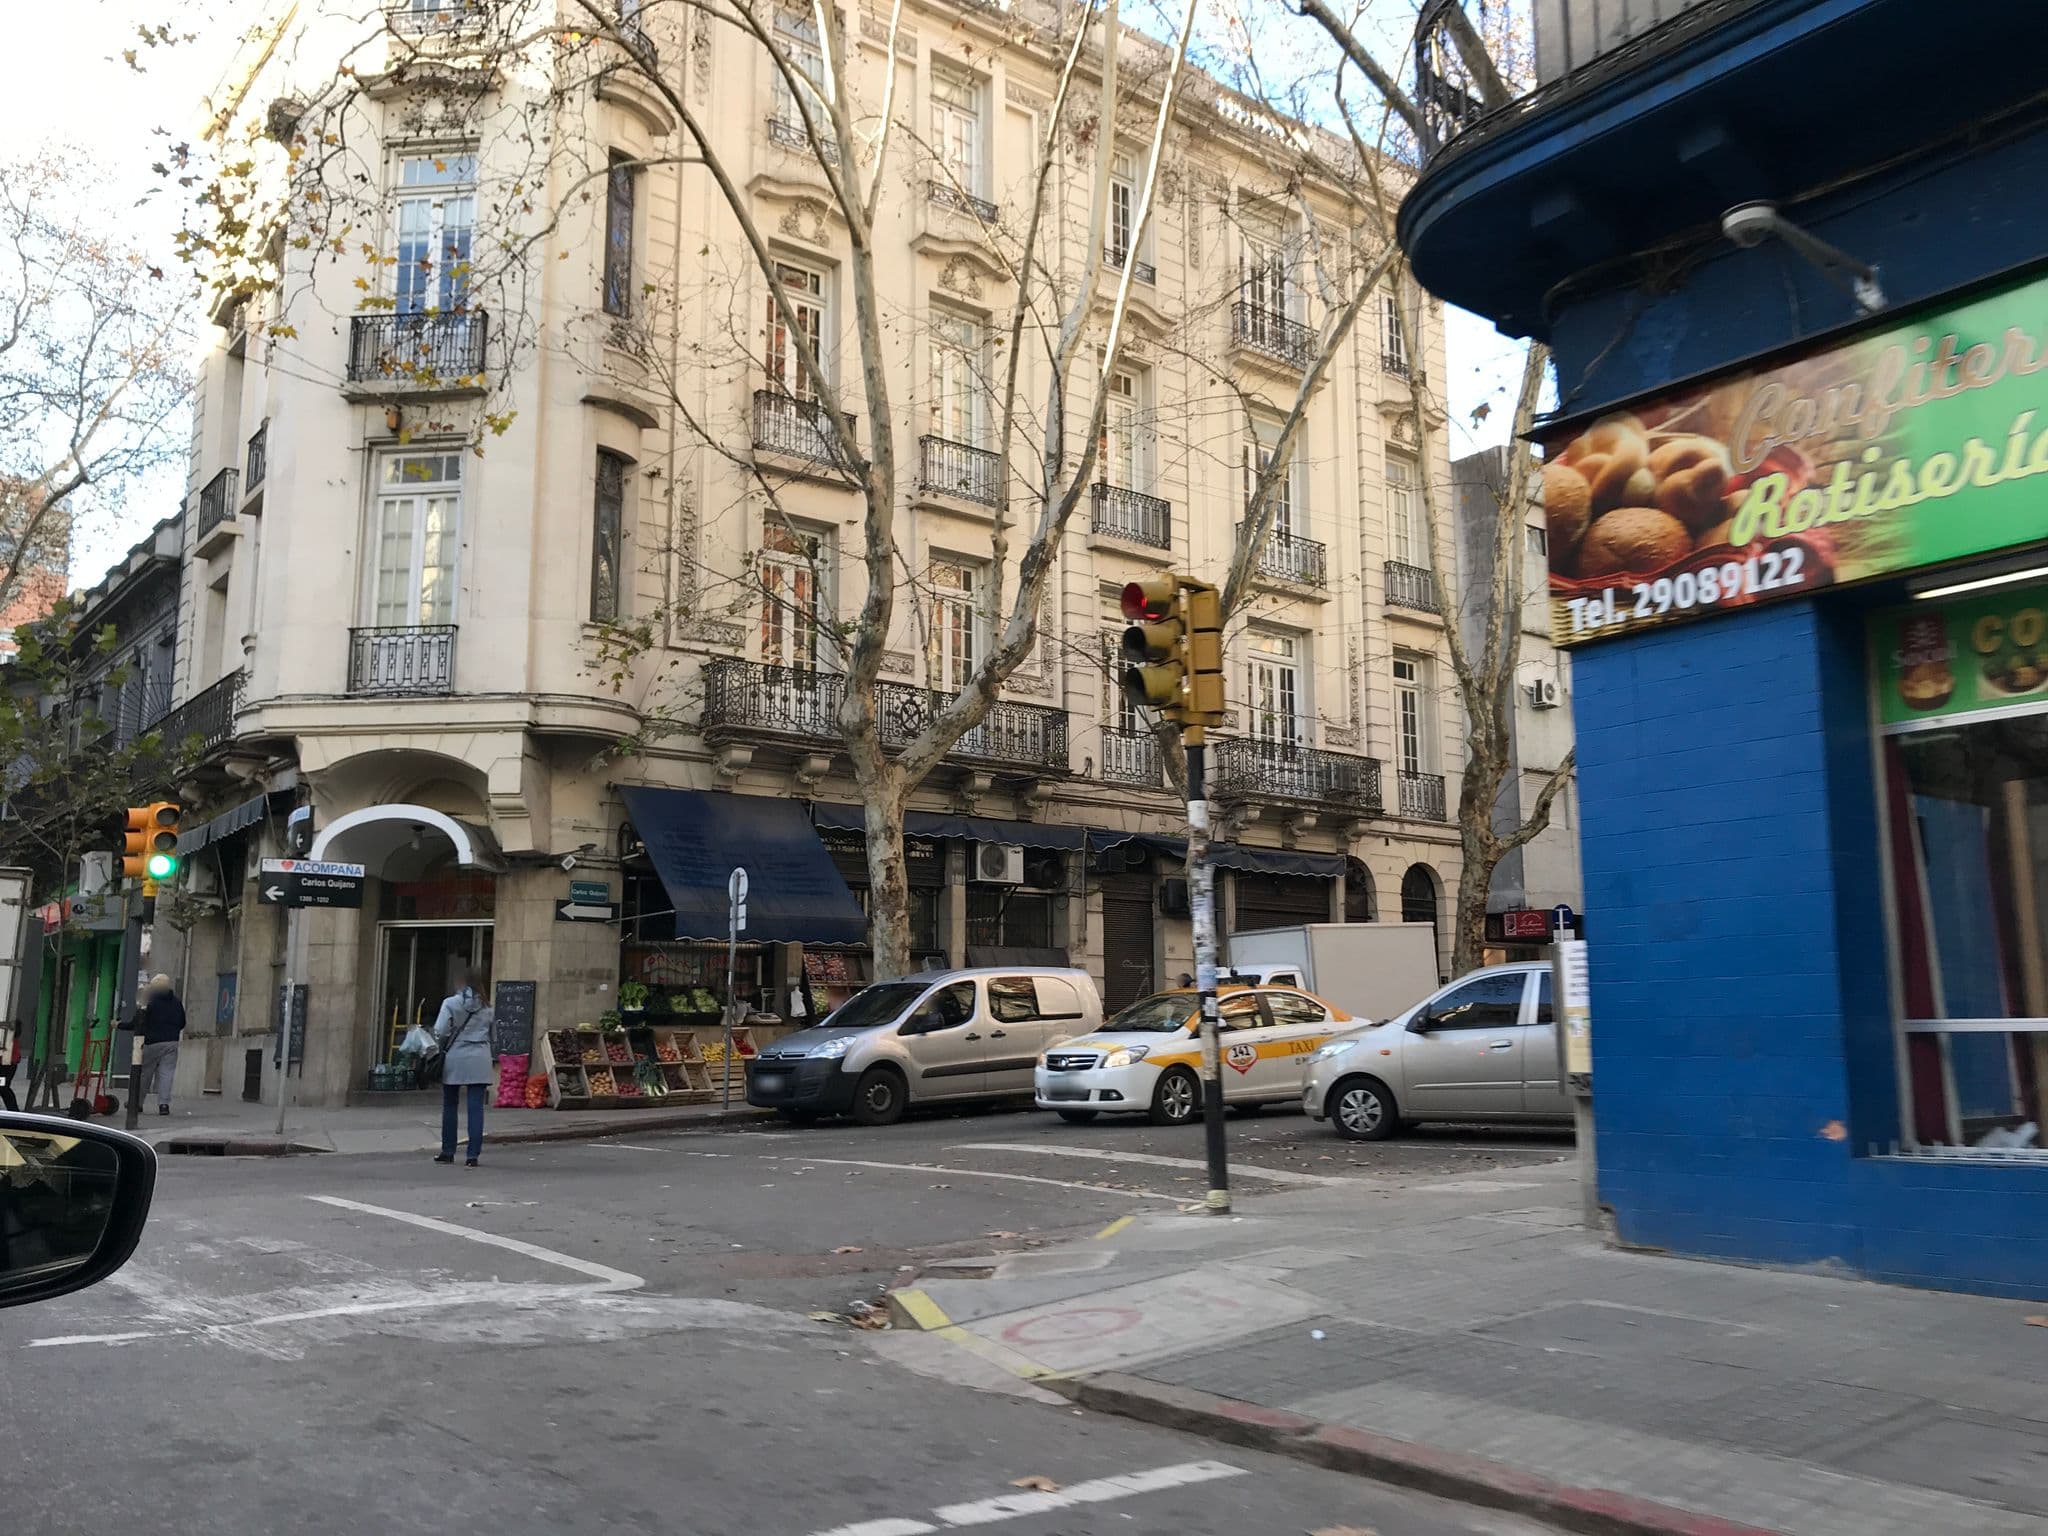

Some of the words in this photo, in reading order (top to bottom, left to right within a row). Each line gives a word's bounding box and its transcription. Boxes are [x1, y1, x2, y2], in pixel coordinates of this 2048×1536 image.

[1731, 327, 2048, 474] Confiter
[1568, 587, 1628, 633] Tel.
[1632, 549, 1805, 618] 29089122
[293, 862, 362, 876] ACOMPAÑA
[301, 878, 326, 888] Carlos
[327, 879, 356, 890] Quijano
[1232, 1045, 1251, 1058] 141
[1287, 1040, 1315, 1054] TAXI
